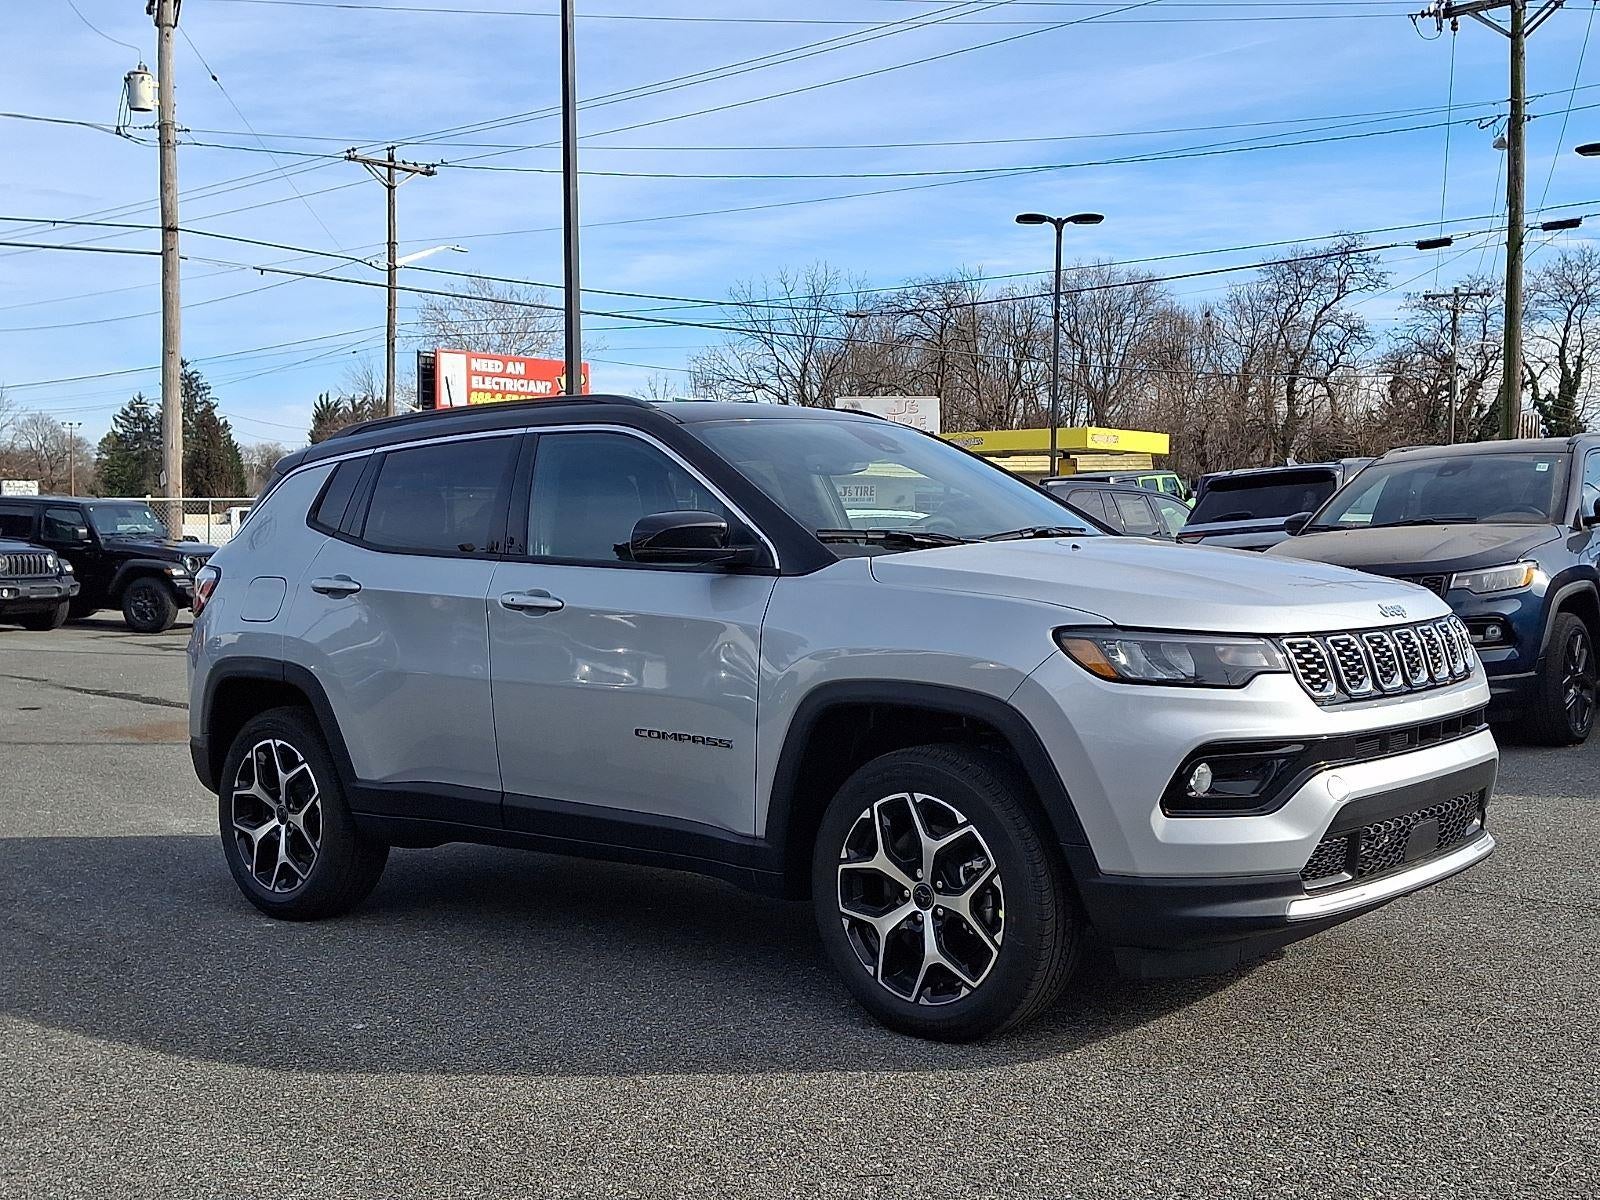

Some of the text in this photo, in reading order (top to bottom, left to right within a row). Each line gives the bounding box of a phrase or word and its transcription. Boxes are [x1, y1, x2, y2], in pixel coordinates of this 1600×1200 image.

[471, 358, 526, 375] NEED AN
[471, 375, 552, 394] ELECTRICIAN?
[855, 485, 875, 497] TIRE
[1377, 603, 1407, 619] Jeep
[634, 728, 733, 750] COMPASS
